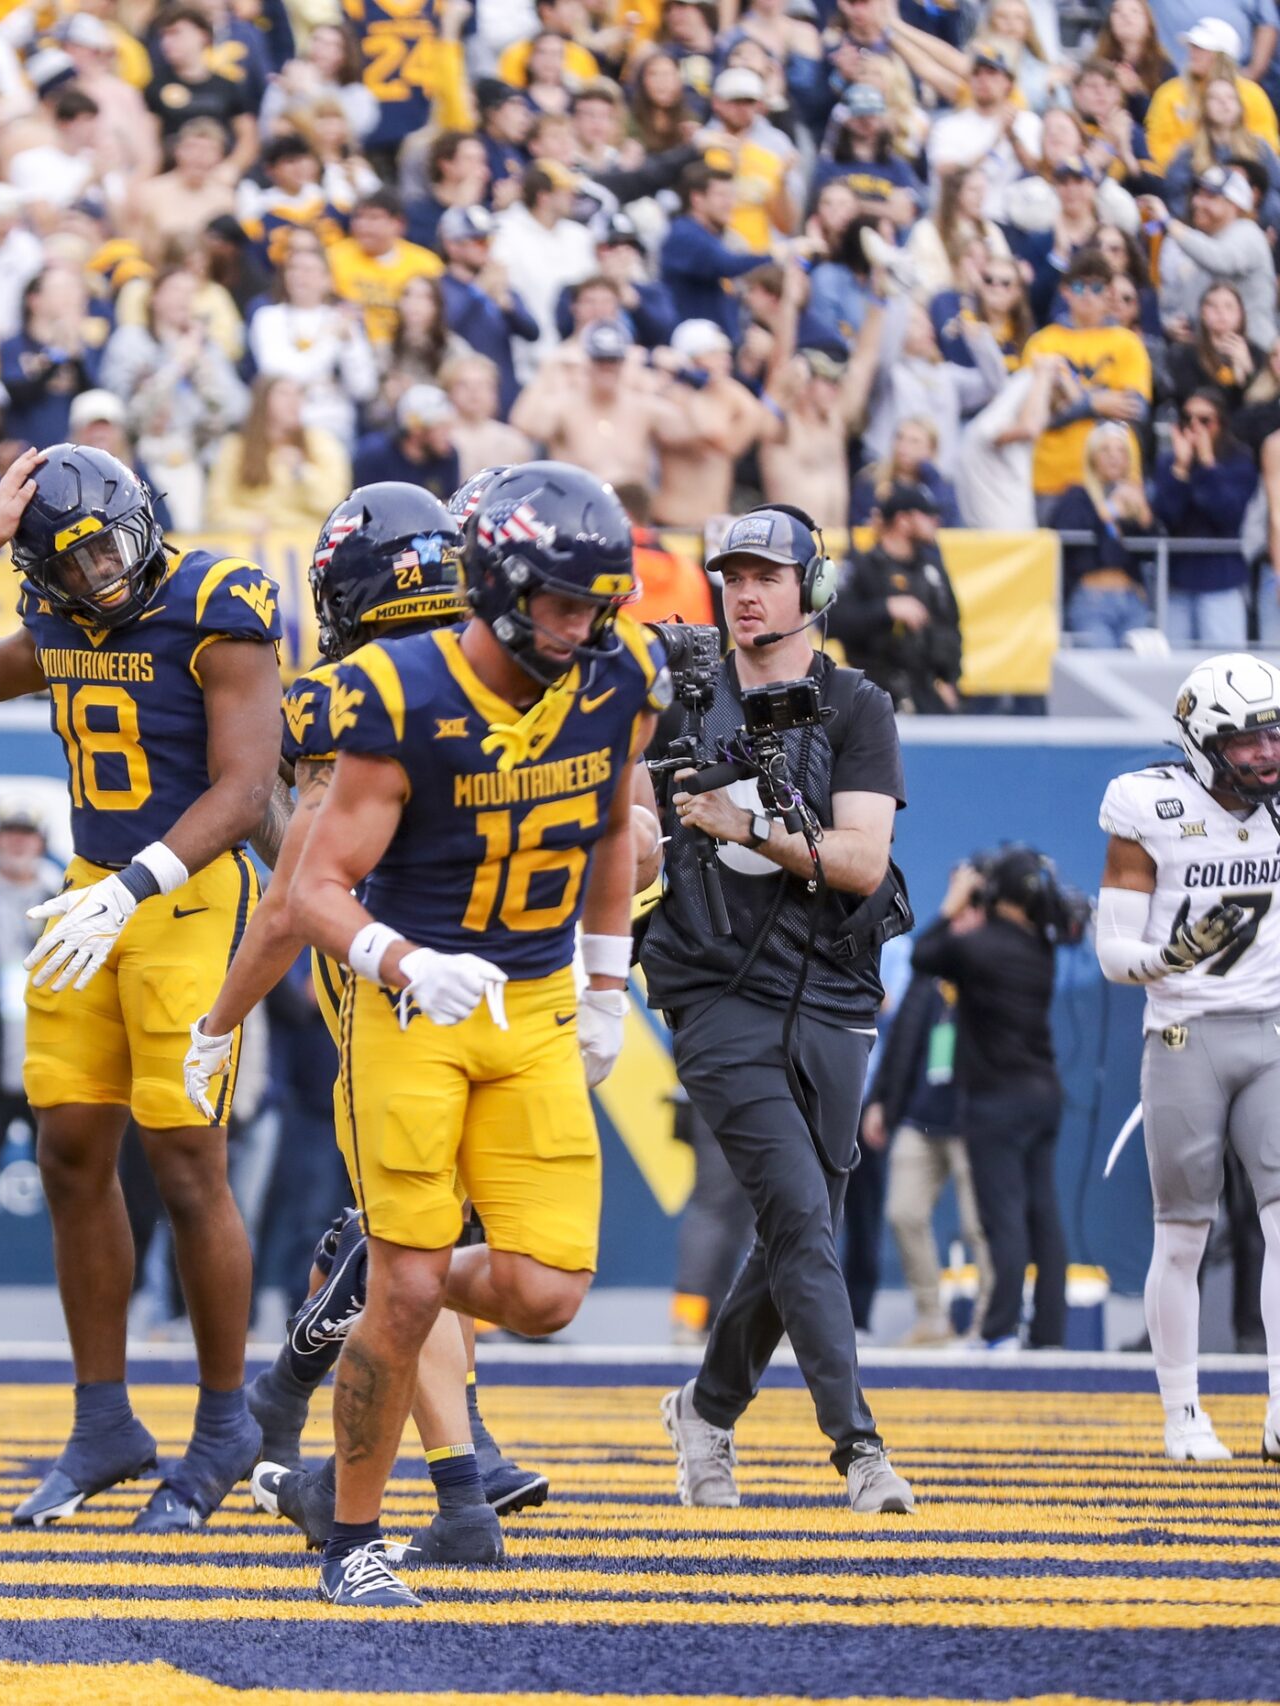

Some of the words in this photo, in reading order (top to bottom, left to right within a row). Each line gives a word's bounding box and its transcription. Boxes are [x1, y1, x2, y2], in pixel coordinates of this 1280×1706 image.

[394, 564, 423, 590] 24
[40, 648, 155, 682] MOUNTAINEERS
[51, 683, 153, 811] 18
[454, 746, 612, 808] MOUNTAINEERS
[460, 790, 599, 933] 16
[1206, 891, 1273, 977] 7
